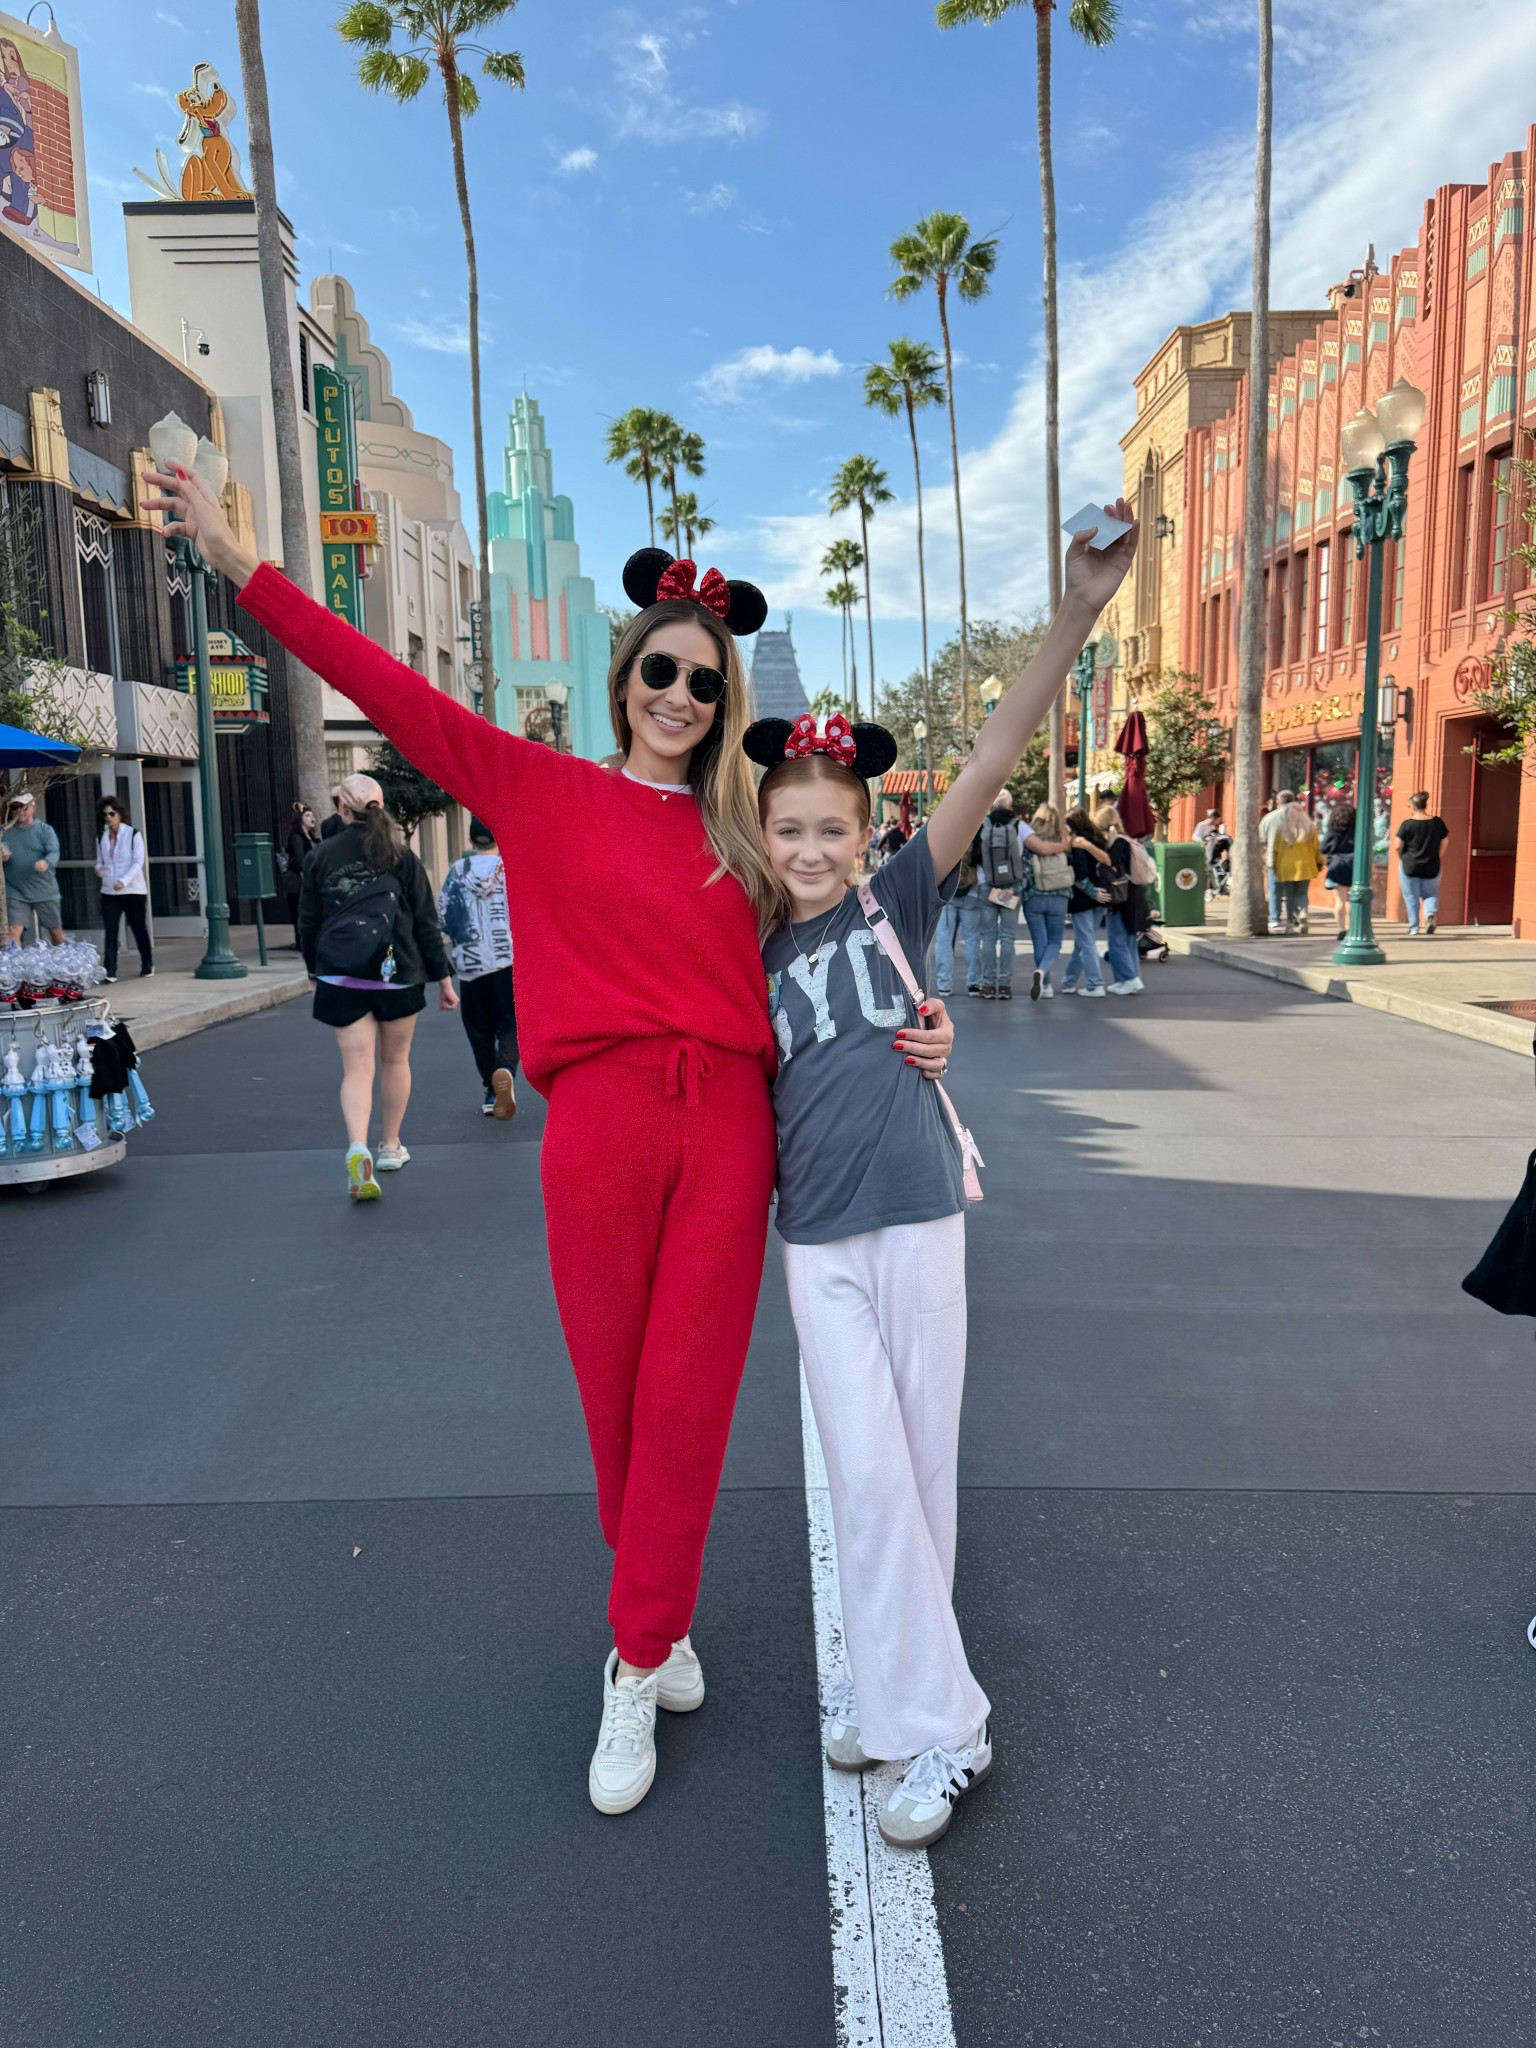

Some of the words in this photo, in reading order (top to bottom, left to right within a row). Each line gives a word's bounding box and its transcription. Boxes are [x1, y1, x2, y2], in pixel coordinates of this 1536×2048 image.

[323, 386, 347, 505] PLUTO'S
[326, 517, 372, 537] TOY
[188, 671, 245, 695] FSHION
[490, 902, 505, 922] THE
